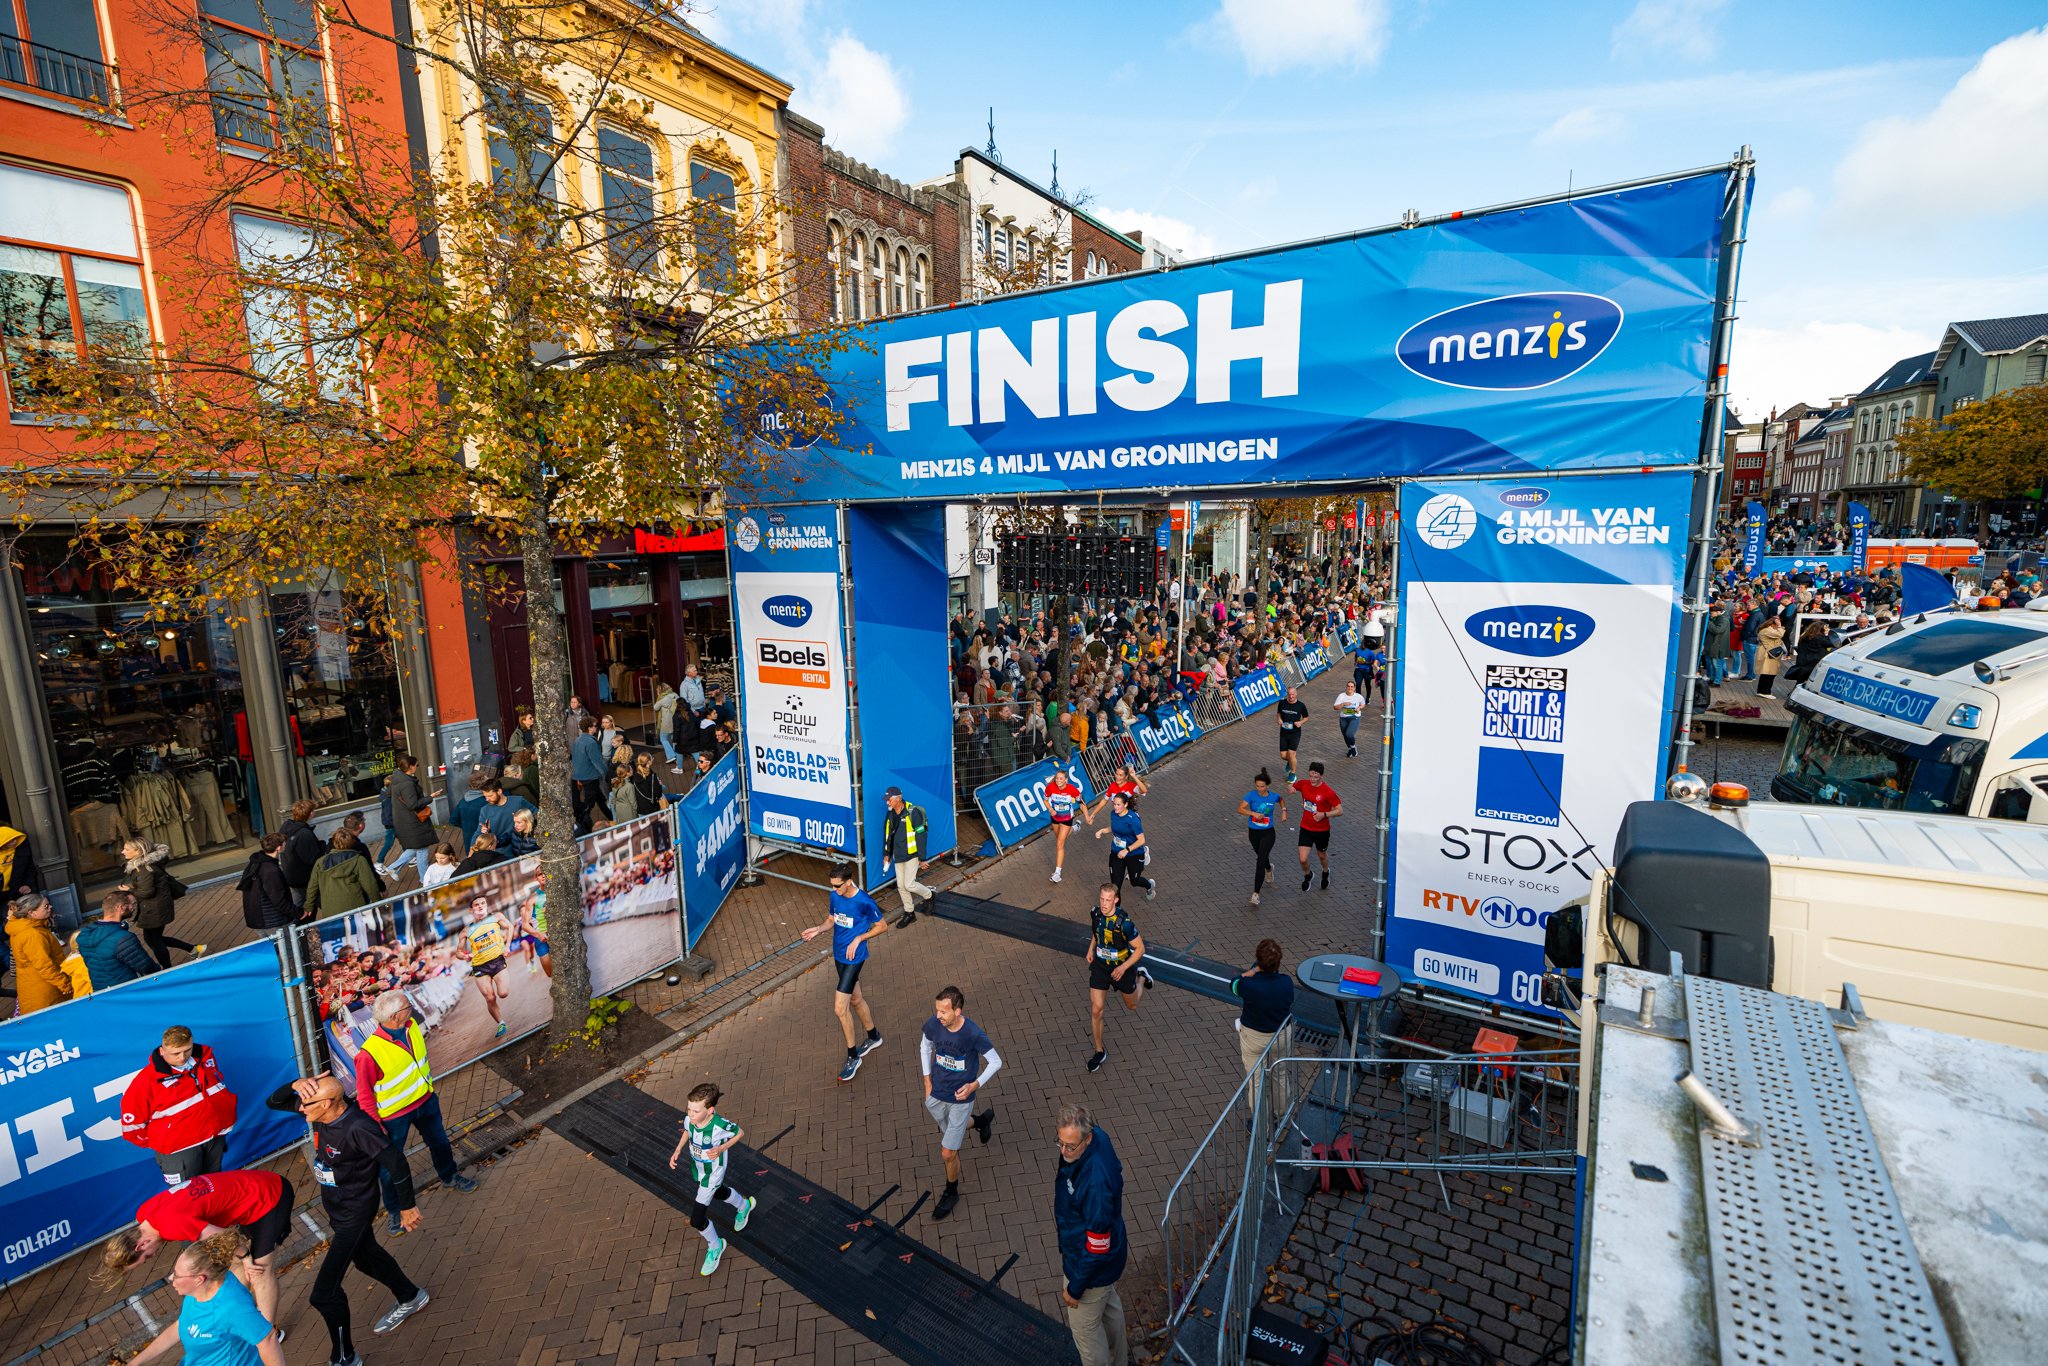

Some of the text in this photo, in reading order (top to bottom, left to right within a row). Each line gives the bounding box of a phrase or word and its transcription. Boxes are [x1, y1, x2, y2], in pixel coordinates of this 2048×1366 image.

[1428, 310, 1588, 364] menzis
[885, 279, 1303, 432] FINISH
[901, 437, 1279, 480] MENZIS 4 MIJL VAN GRONINGEN
[1506, 491, 1543, 503] menzis
[1497, 507, 1656, 527] 4 MIJL VAN
[768, 536, 833, 549] GRONINGEN
[776, 525, 801, 538] MIJL
[803, 525, 827, 537] VAN
[1496, 525, 1670, 545] GRONINGEN
[976, 550, 990, 561] Etos
[769, 601, 807, 619] menzis
[1483, 616, 1577, 643] menzis
[759, 643, 826, 667] Boels
[802, 672, 827, 685] RENTAL
[1487, 666, 1563, 680] JEUGD
[1487, 678, 1564, 691] FONDS
[1486, 689, 1561, 717] SPORT &
[1824, 673, 1930, 720] GEBR. DRIJFHOUT
[773, 711, 817, 727] POUW
[779, 724, 810, 737] RENT
[1485, 713, 1562, 741] CULTUUR
[773, 734, 817, 744] AUTOVERHUUR
[375, 750, 394, 759] OUT
[755, 745, 827, 769] DAGBLAD
[757, 760, 829, 784] NOORDEN
[766, 817, 792, 831] GO WITH
[1477, 808, 1558, 826] CENTERCOM
[805, 818, 845, 847] GOLAZO
[1440, 825, 1596, 881] STOX
[1467, 871, 1560, 894] ENERGY SOCKS
[1423, 889, 1481, 917] RTV
[1422, 957, 1478, 984] GO WITH
[7, 1038, 65, 1067] VAN
[3, 1219, 71, 1264] GOLAZO
